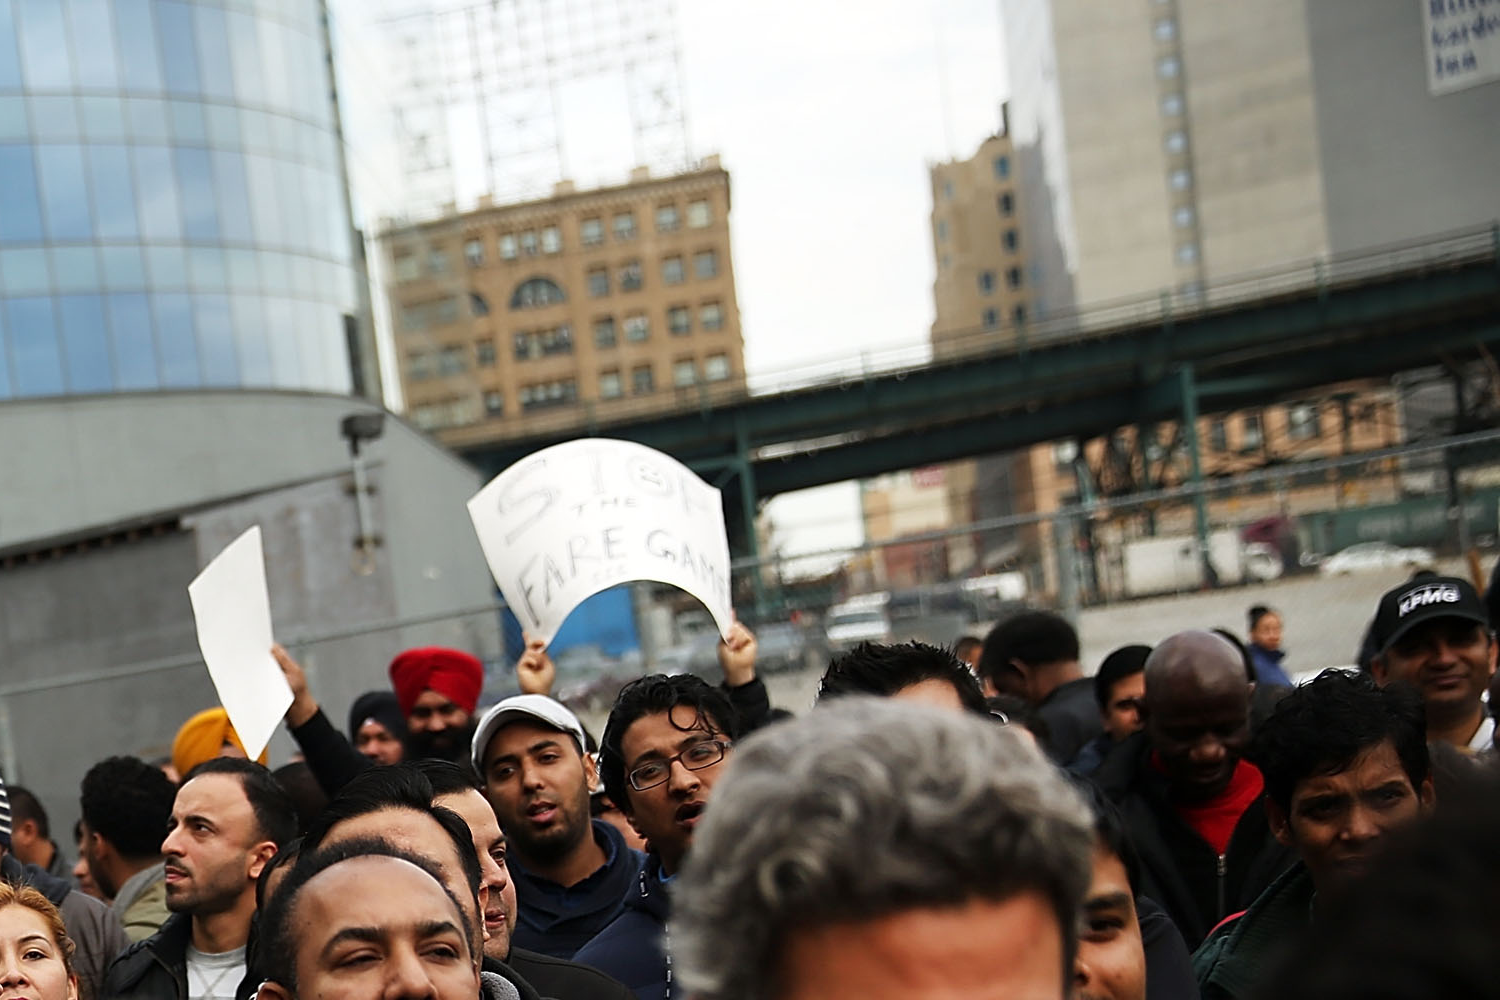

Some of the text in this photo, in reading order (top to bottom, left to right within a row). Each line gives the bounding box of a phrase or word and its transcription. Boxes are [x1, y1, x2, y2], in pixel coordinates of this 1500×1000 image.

[570, 495, 637, 517] THE
[515, 525, 627, 629] FARE
[1398, 586, 1460, 618] KPMG
